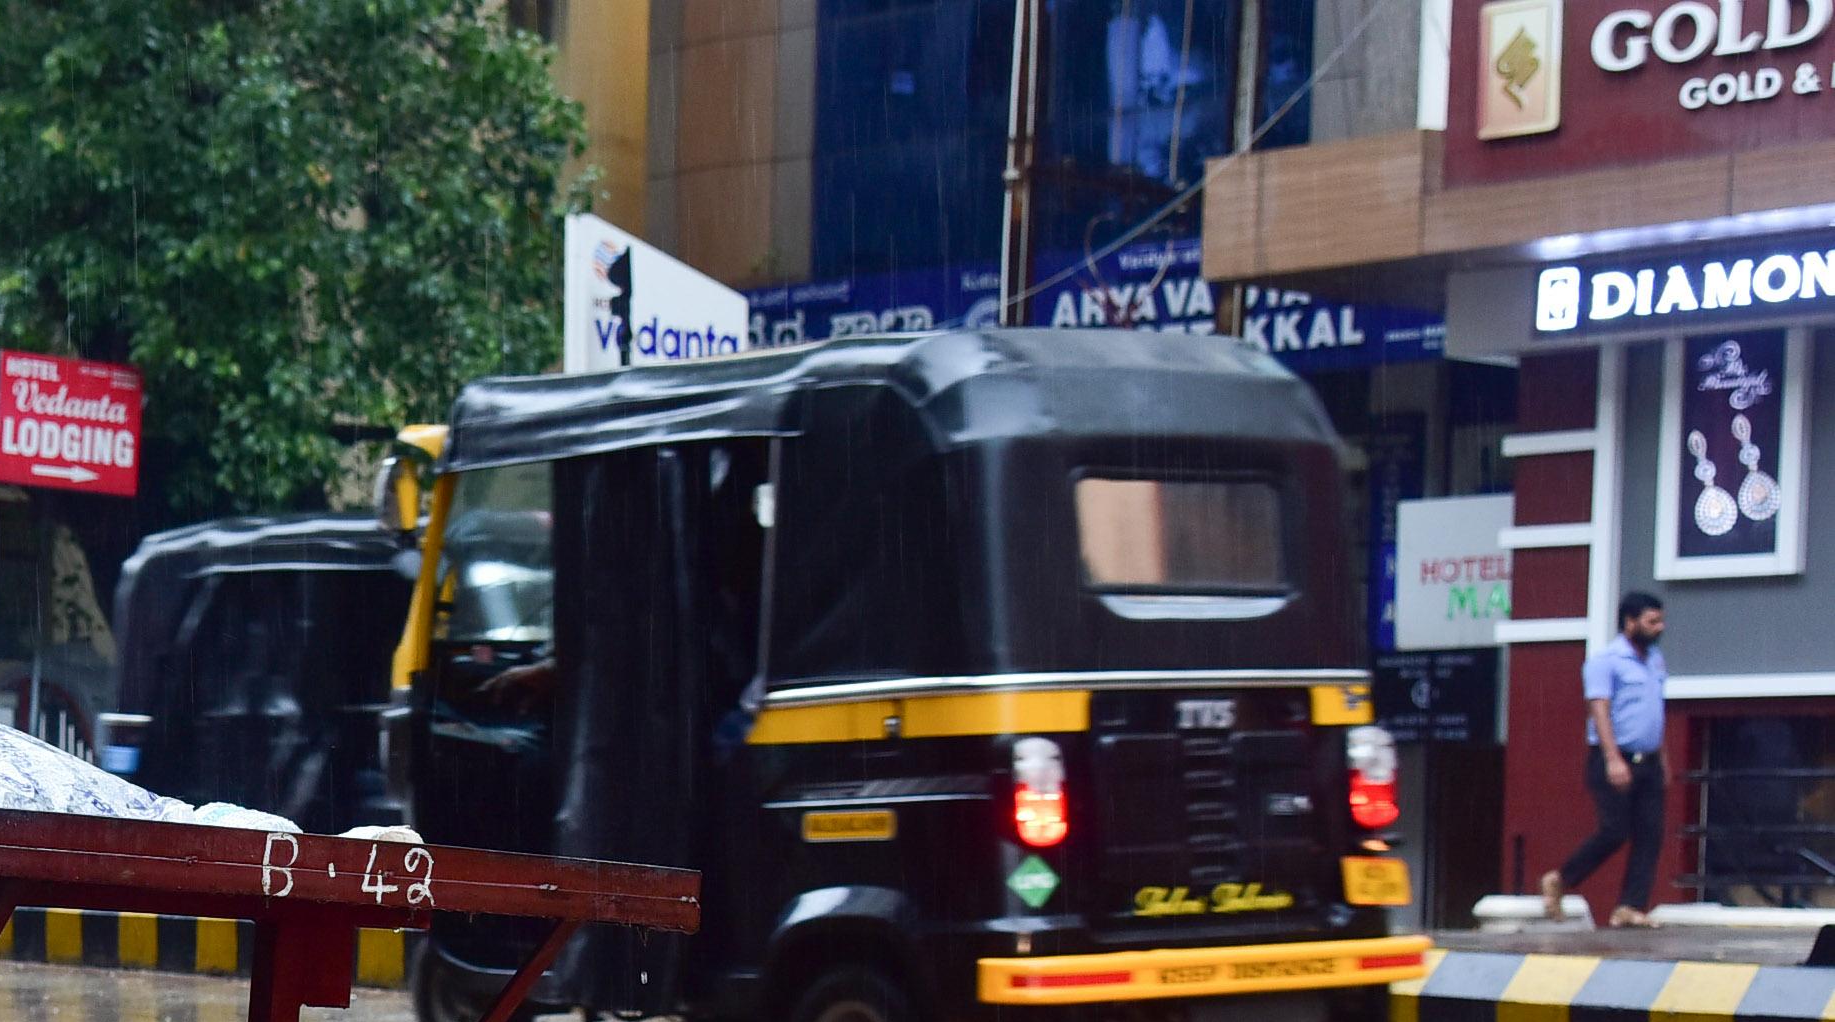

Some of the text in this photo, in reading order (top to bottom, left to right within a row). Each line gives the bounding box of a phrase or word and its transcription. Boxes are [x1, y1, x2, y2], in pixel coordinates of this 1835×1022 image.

[1590, 0, 1833, 72] GOLD
[1678, 63, 1822, 109] GOLD &
[6, 356, 60, 382] HOTEL
[12, 378, 128, 424] Vedanta
[2, 416, 134, 468] LODGING
[1420, 554, 1509, 584] HOTEL
